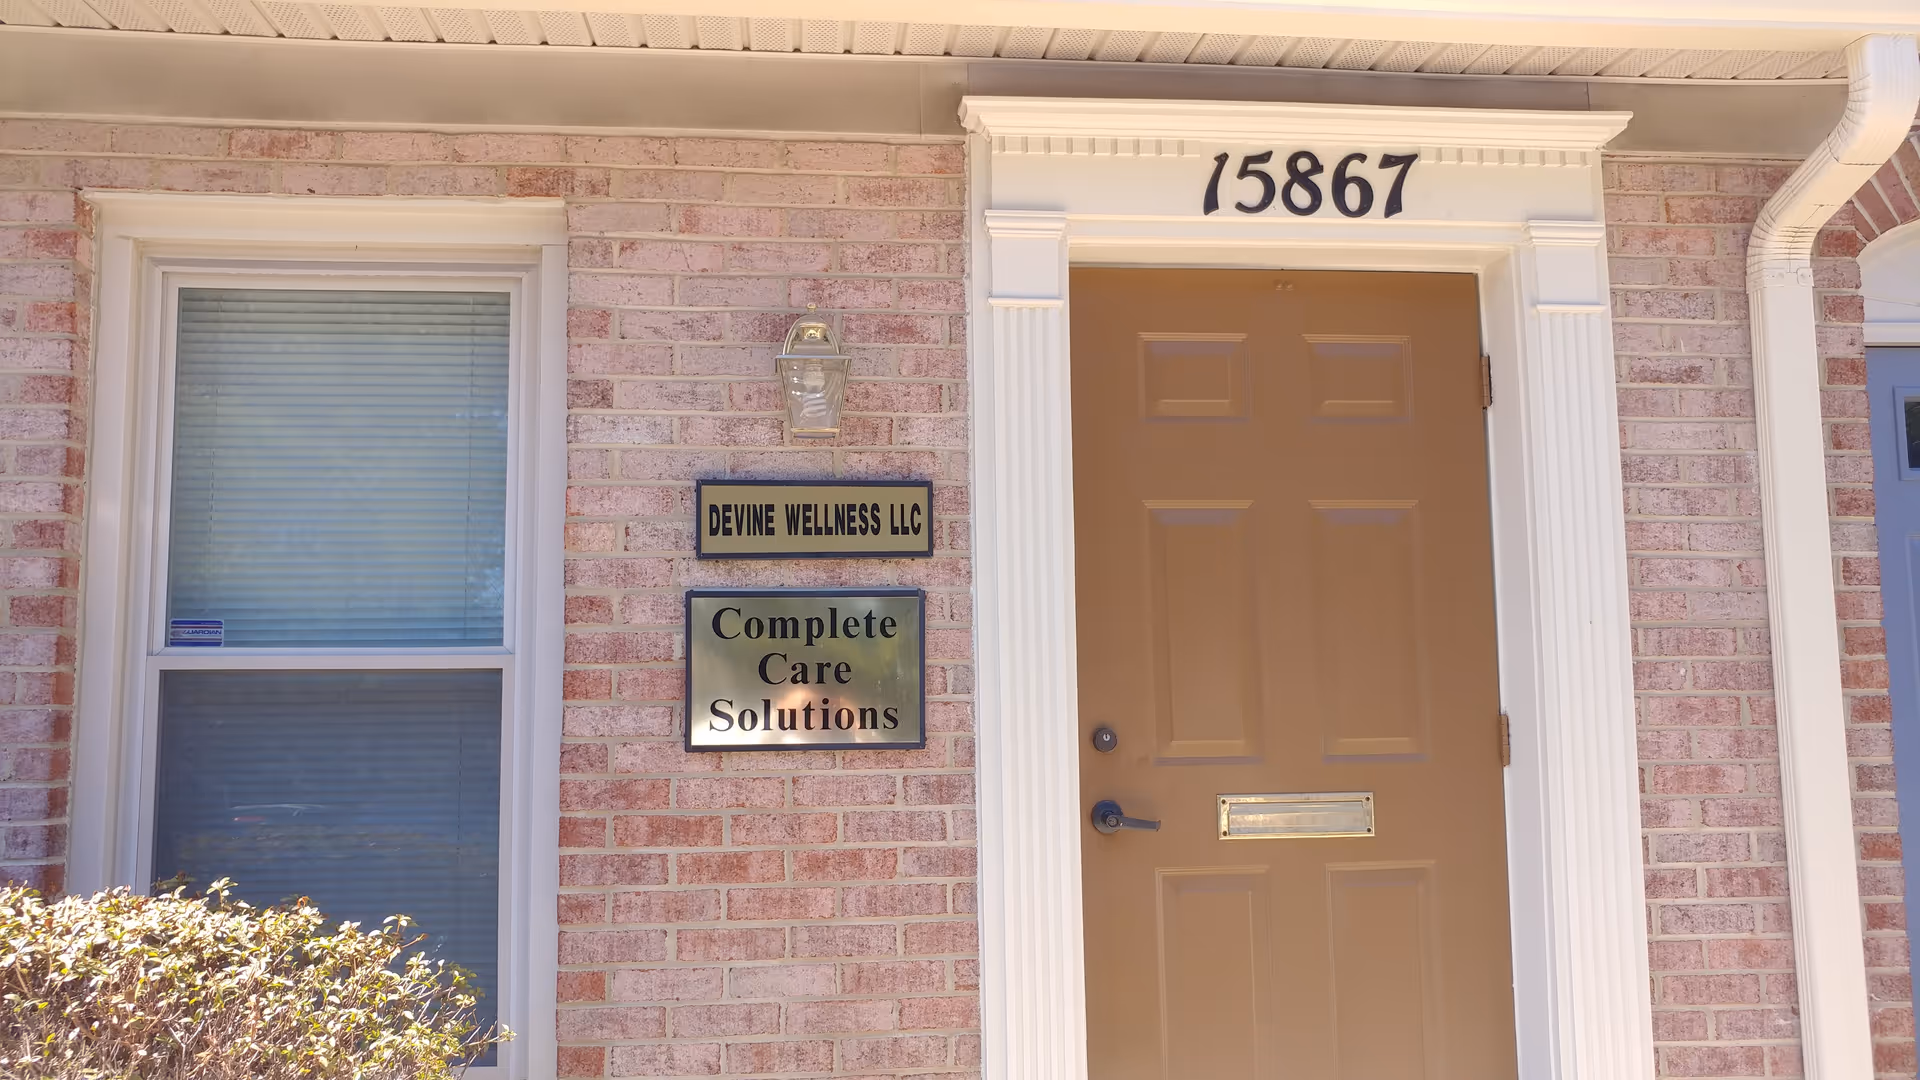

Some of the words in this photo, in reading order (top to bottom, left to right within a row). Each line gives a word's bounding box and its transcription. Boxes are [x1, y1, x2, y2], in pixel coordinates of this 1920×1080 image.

[1203, 150, 1418, 218] 15867
[709, 503, 775, 536] DEVINE
[785, 502, 881, 536] WELLNESS
[890, 503, 922, 536] LLC
[711, 607, 897, 646] Complete
[758, 652, 852, 685] Care
[709, 698, 899, 732] Solutions
